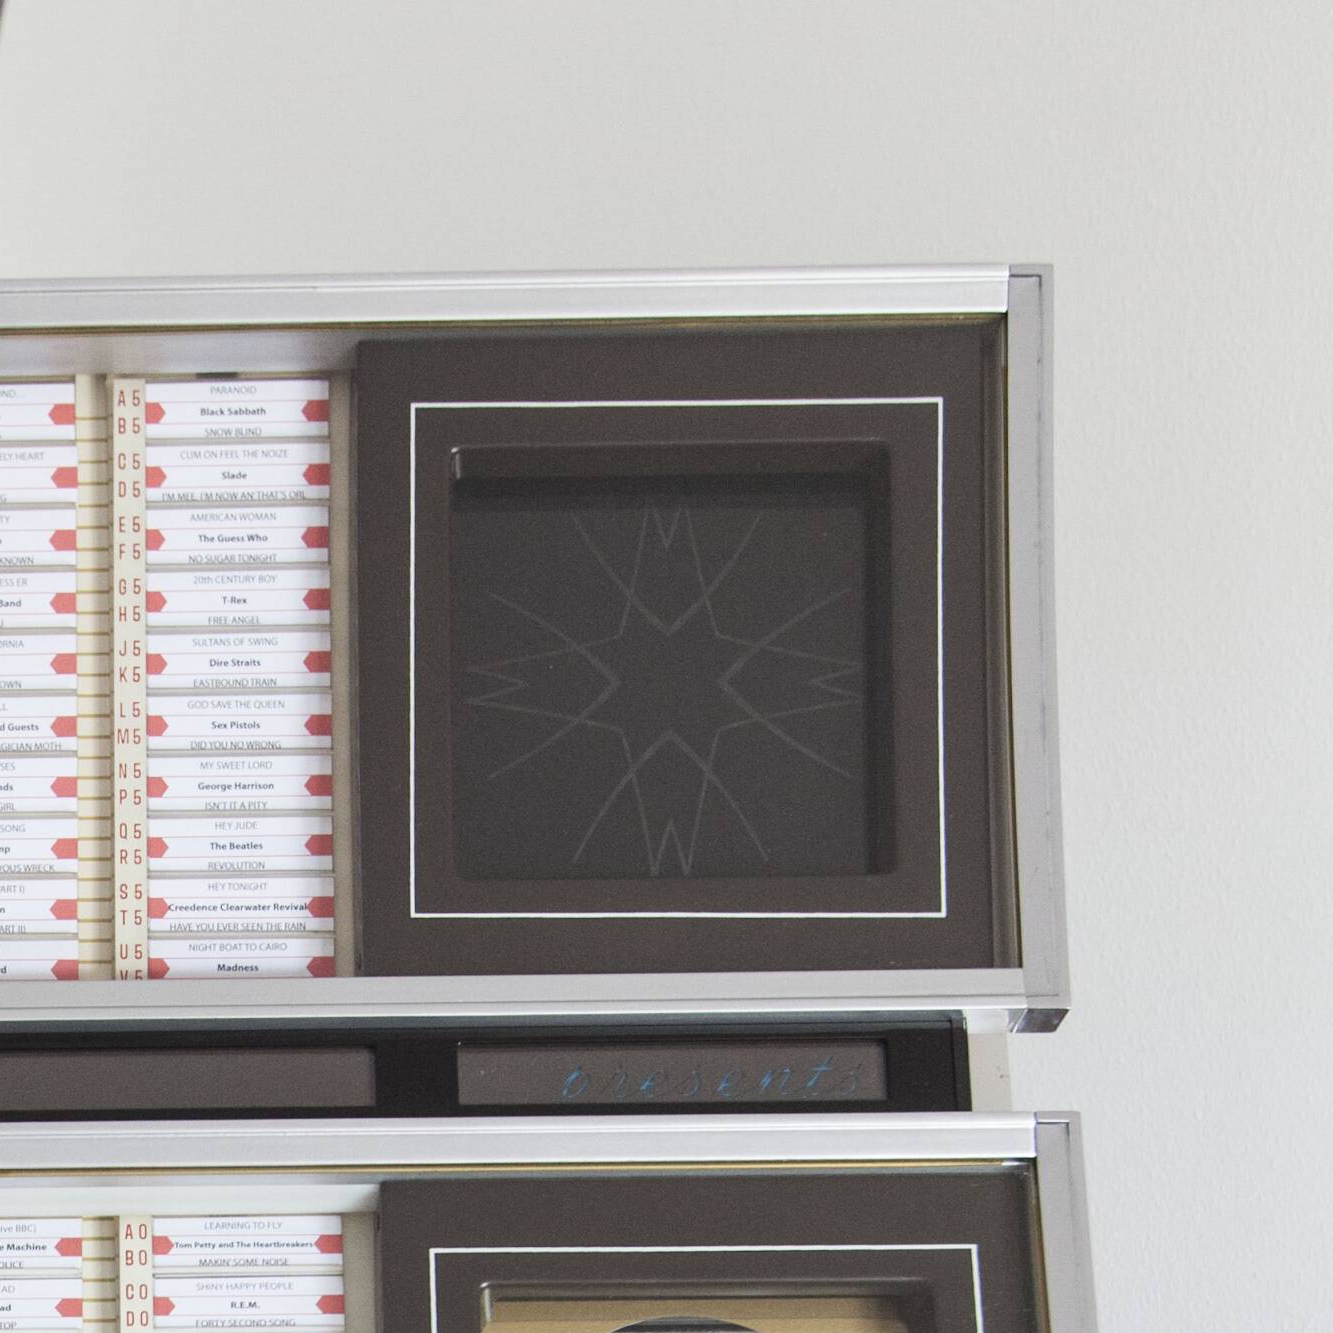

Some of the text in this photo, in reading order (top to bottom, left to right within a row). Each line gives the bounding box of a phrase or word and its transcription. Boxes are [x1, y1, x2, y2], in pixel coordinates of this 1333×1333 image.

[211, 720, 261, 729] Sex Pistols
[197, 781, 275, 793] George Harrison
[210, 841, 264, 851] The Beatles
[217, 963, 259, 972] Madness
